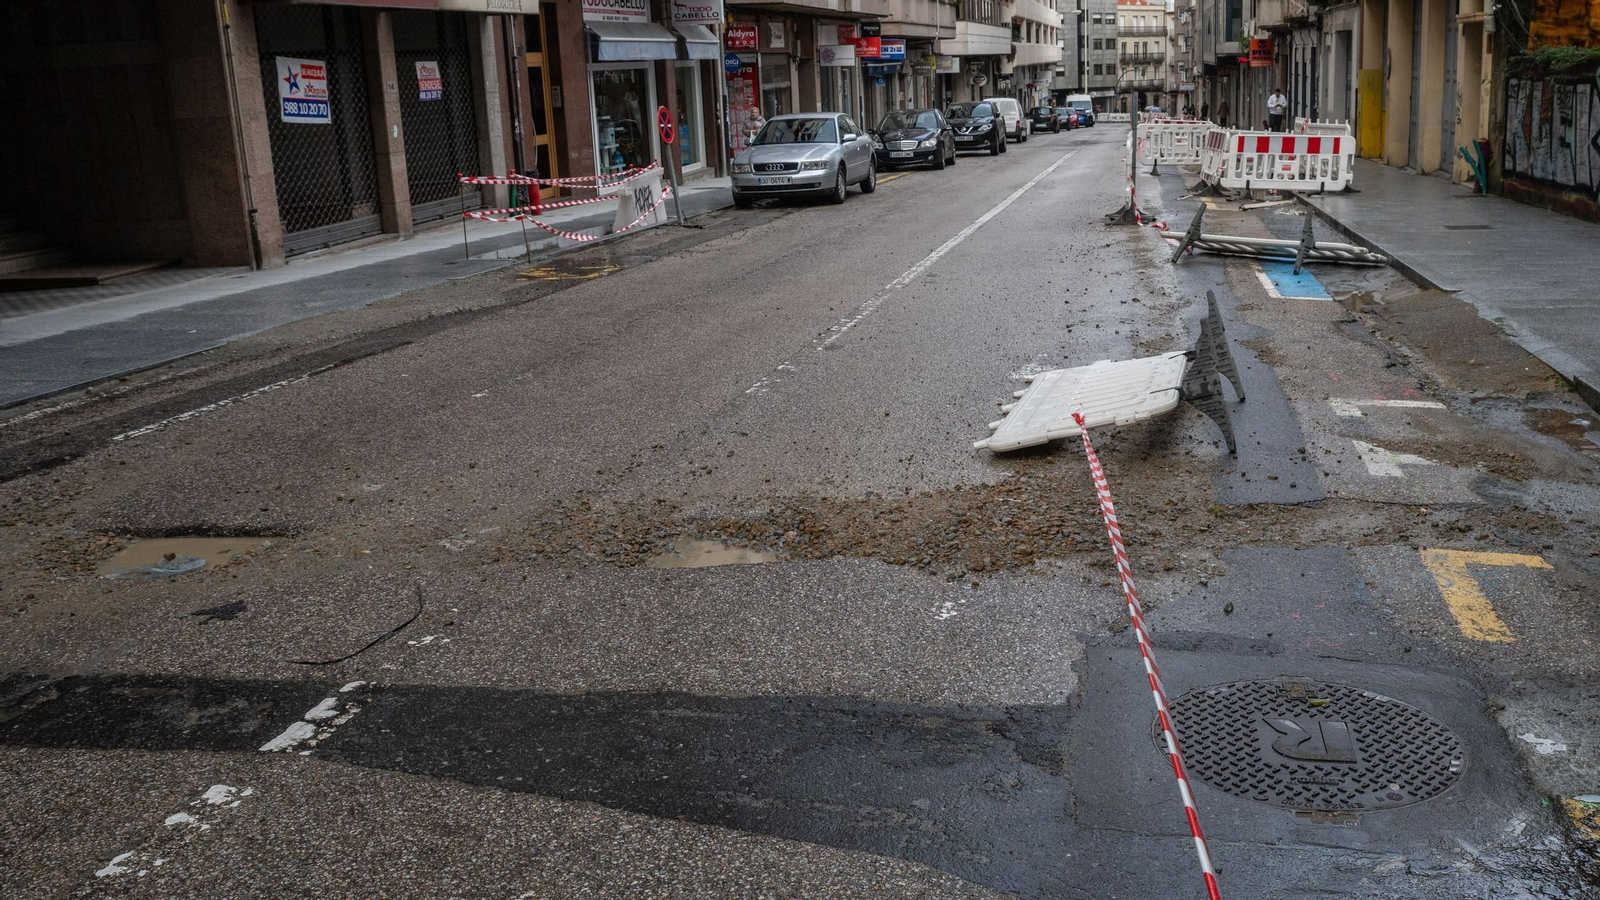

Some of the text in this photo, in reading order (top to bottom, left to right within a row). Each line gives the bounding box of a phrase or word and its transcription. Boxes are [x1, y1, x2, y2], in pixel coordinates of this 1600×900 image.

[727, 29, 754, 39] Aldyra
[738, 66, 752, 75] yra
[388, 83, 394, 91] 14
[284, 102, 327, 115] 988 10 20 70
